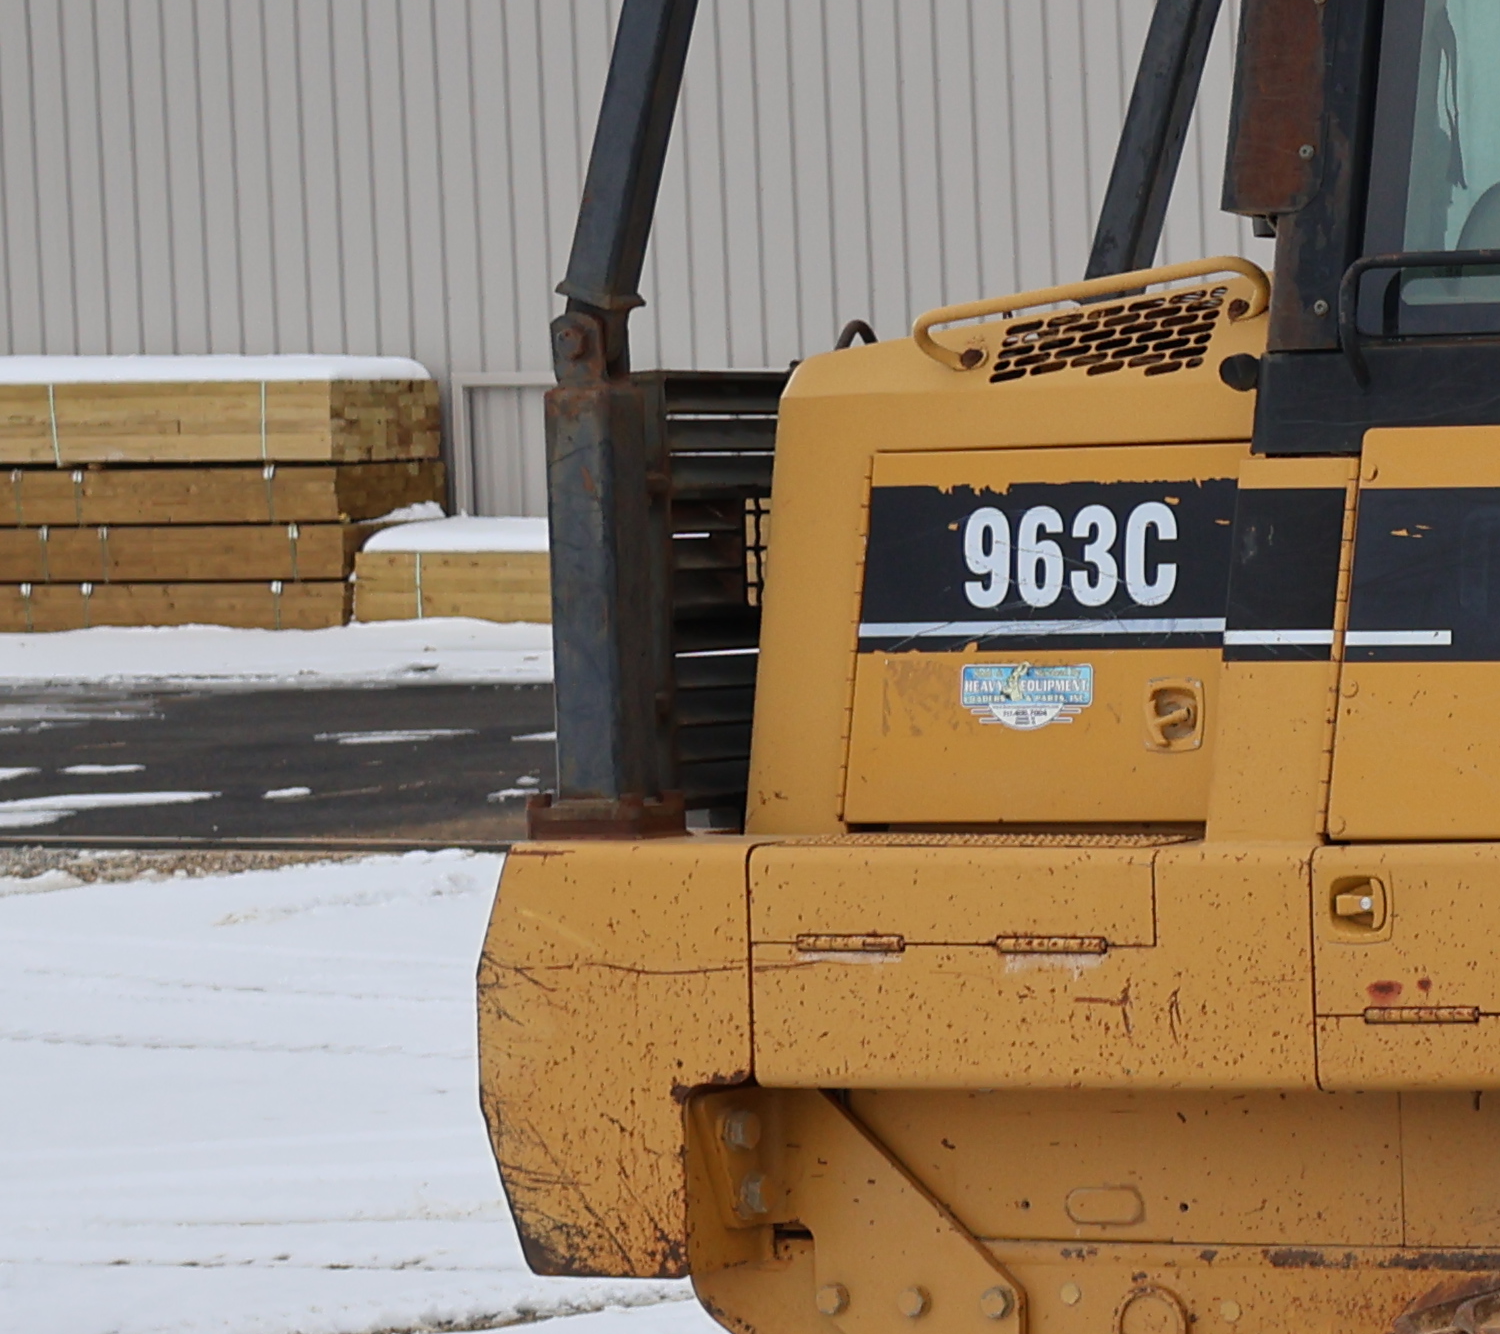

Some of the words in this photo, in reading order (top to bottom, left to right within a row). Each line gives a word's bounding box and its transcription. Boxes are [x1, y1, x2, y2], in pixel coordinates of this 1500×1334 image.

[964, 501, 1178, 608] 963C
[965, 680, 1002, 692] HEAVY
[1021, 679, 1088, 692] EQUIPMENT
